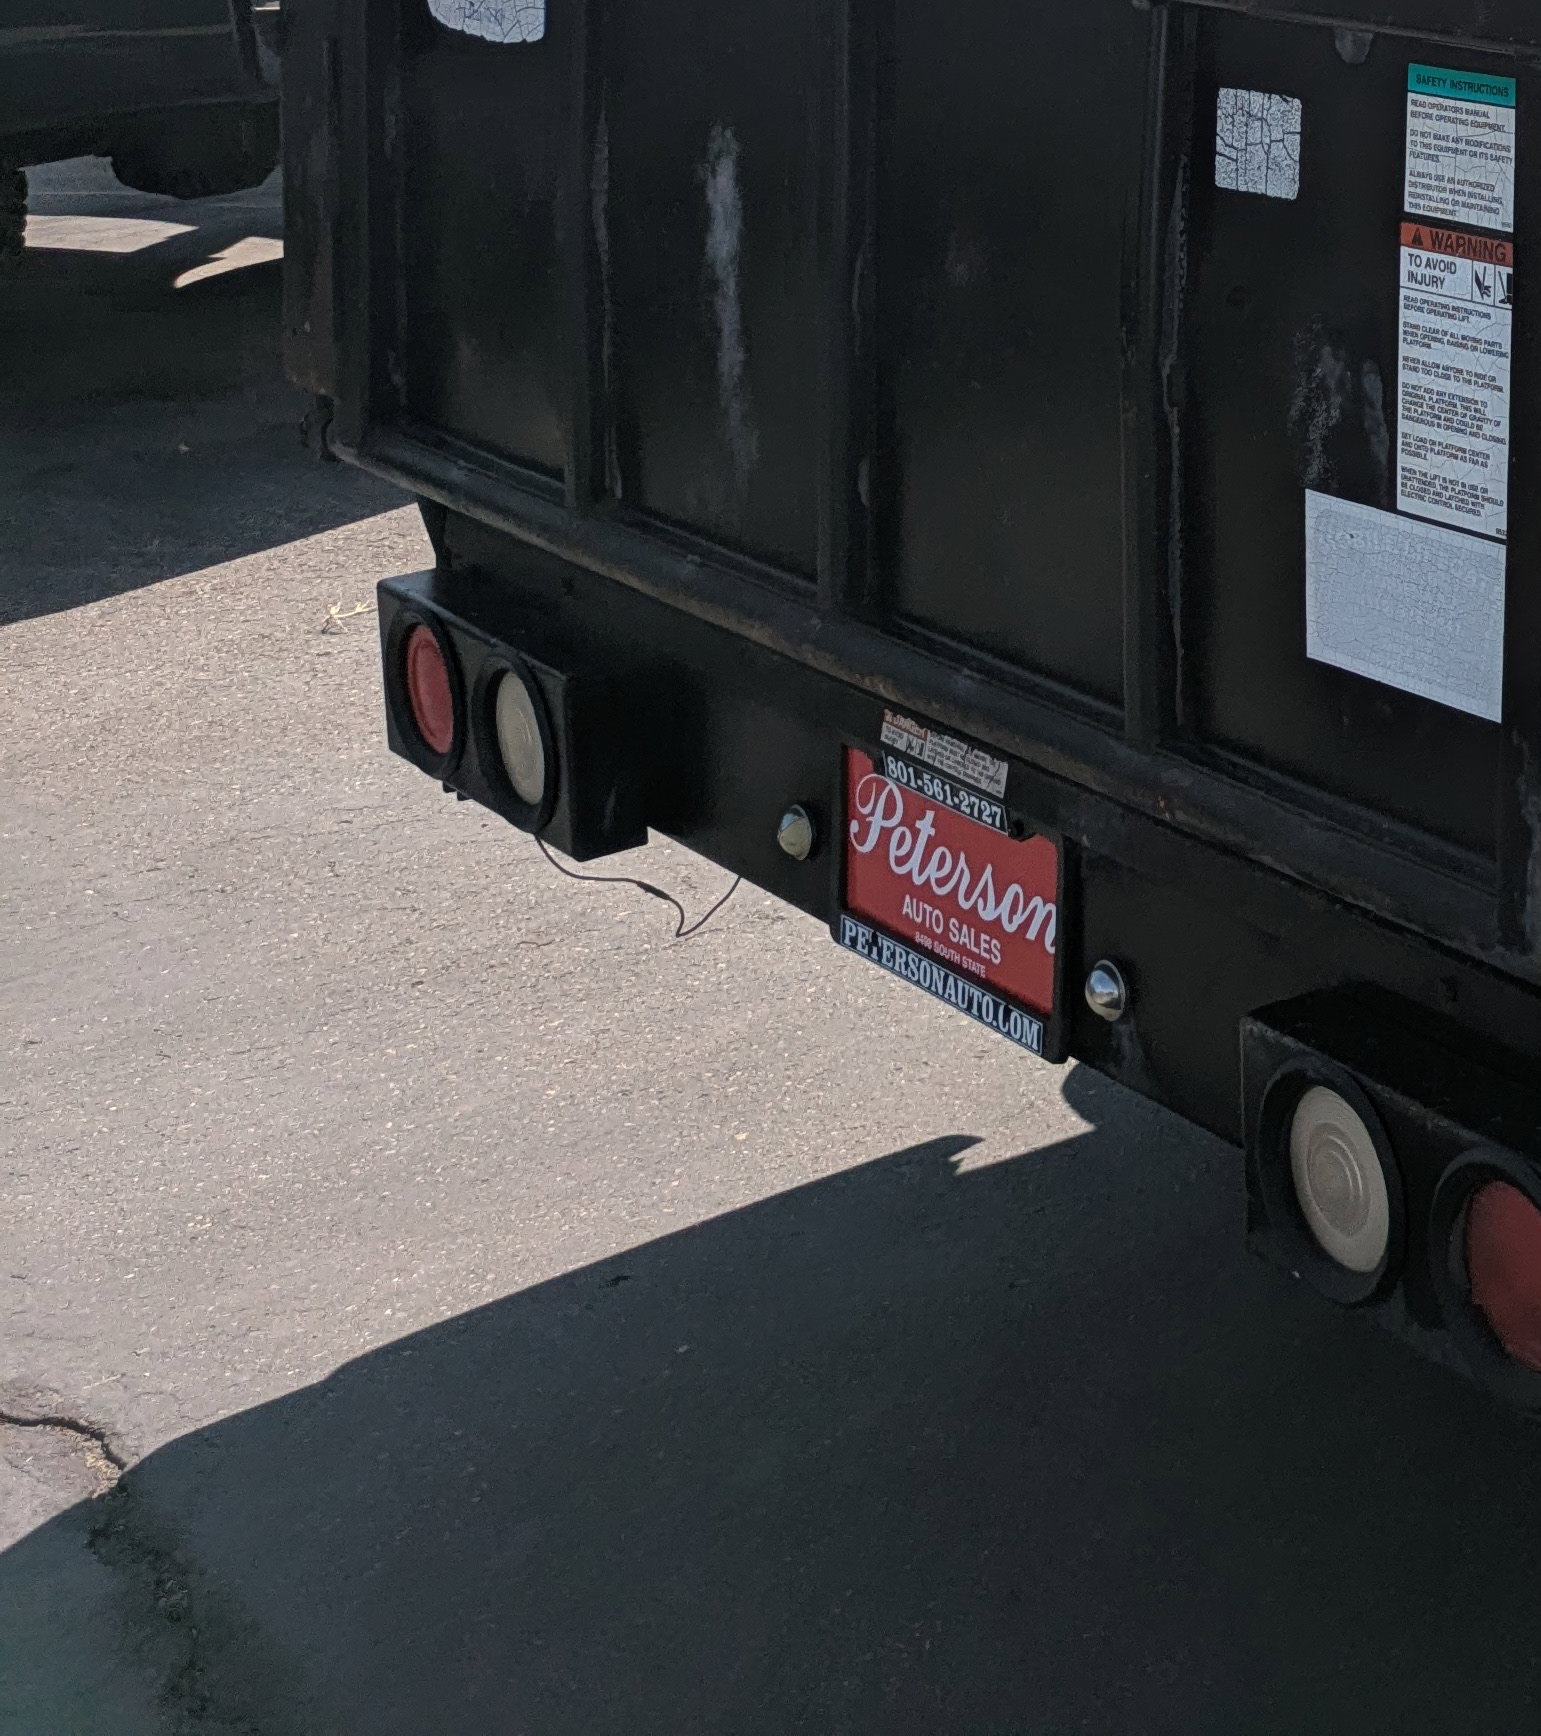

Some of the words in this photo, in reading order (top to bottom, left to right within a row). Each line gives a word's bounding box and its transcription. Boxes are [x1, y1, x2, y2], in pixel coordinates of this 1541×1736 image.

[1416, 74, 1447, 88] SAFETY
[1449, 79, 1509, 97] INSTRUCTIONS
[1489, 153, 1512, 164] SAFETY
[1429, 230, 1506, 262] WARNING
[1408, 253, 1422, 267] TO
[1425, 256, 1457, 274] AVOID
[1408, 270, 1445, 289] INJURY
[887, 754, 1004, 828] 801-561-2727
[849, 773, 1056, 954] Peterson
[902, 893, 944, 933] AUTO
[948, 917, 1002, 965] SALES
[934, 941, 960, 964] SOUTH
[962, 956, 986, 978] STATE
